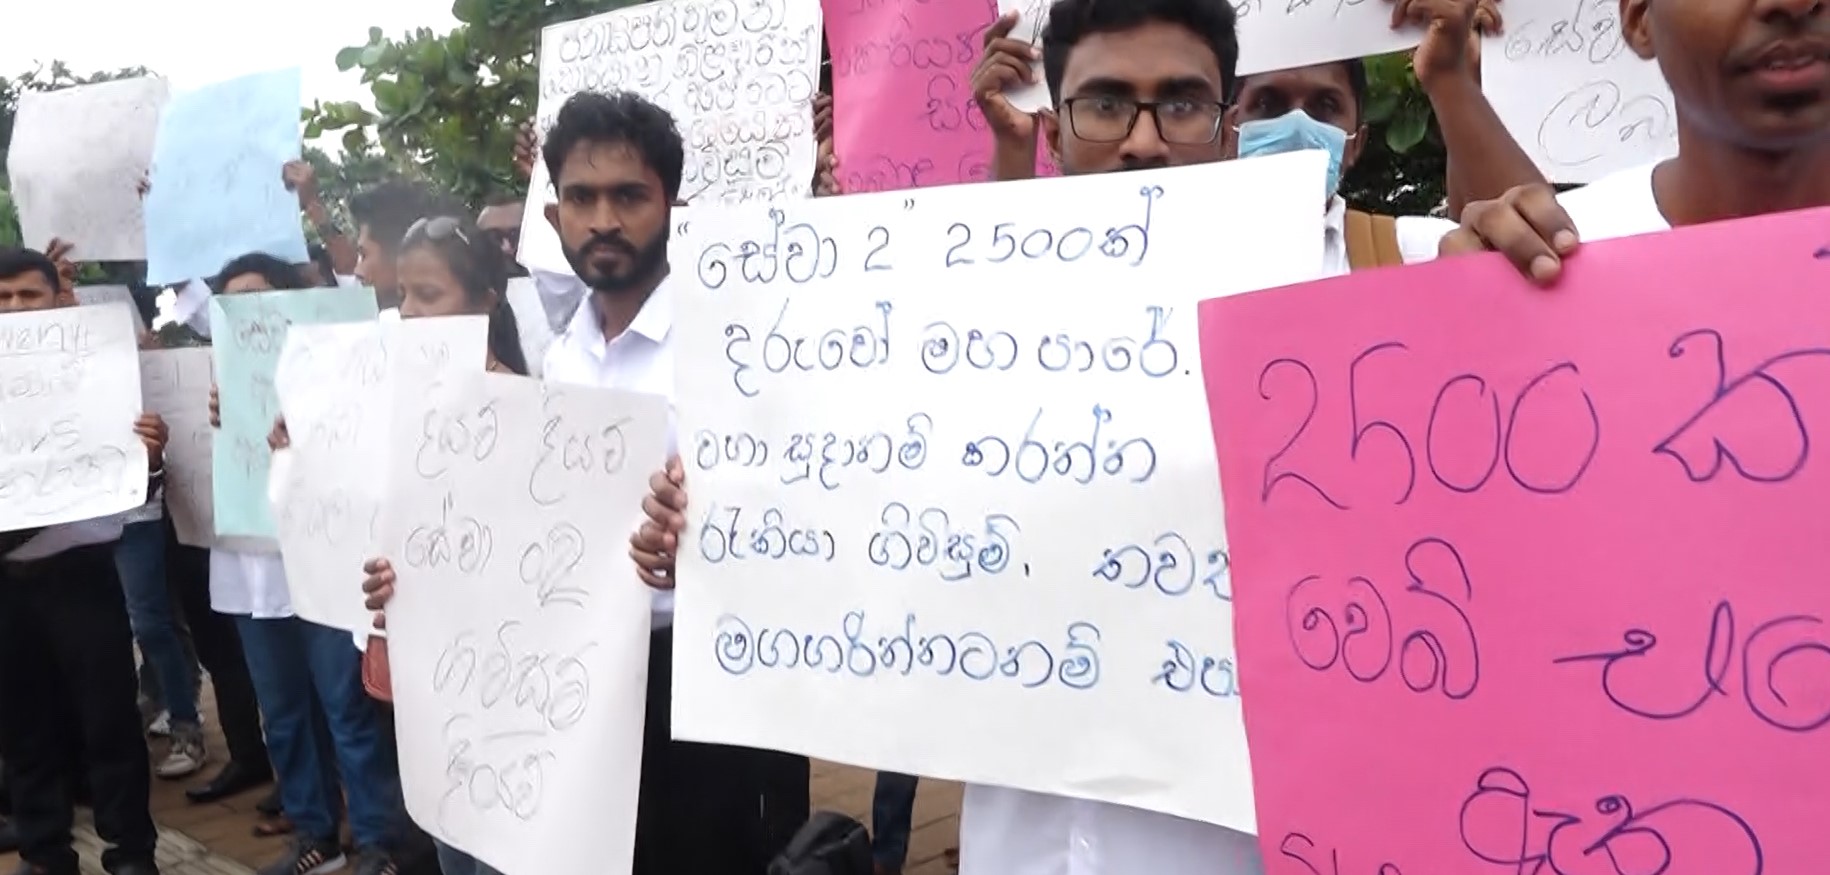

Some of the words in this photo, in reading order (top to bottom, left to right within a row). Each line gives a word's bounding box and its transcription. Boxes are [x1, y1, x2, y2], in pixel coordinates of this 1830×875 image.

[725, 297, 893, 398] දරුවෝ
[921, 321, 1018, 375] මහ
[1038, 305, 1190, 378] පාරේ.
[697, 430, 768, 470] වහා
[961, 403, 1156, 485] කරන්න
[1259, 342, 1599, 510] 2500
